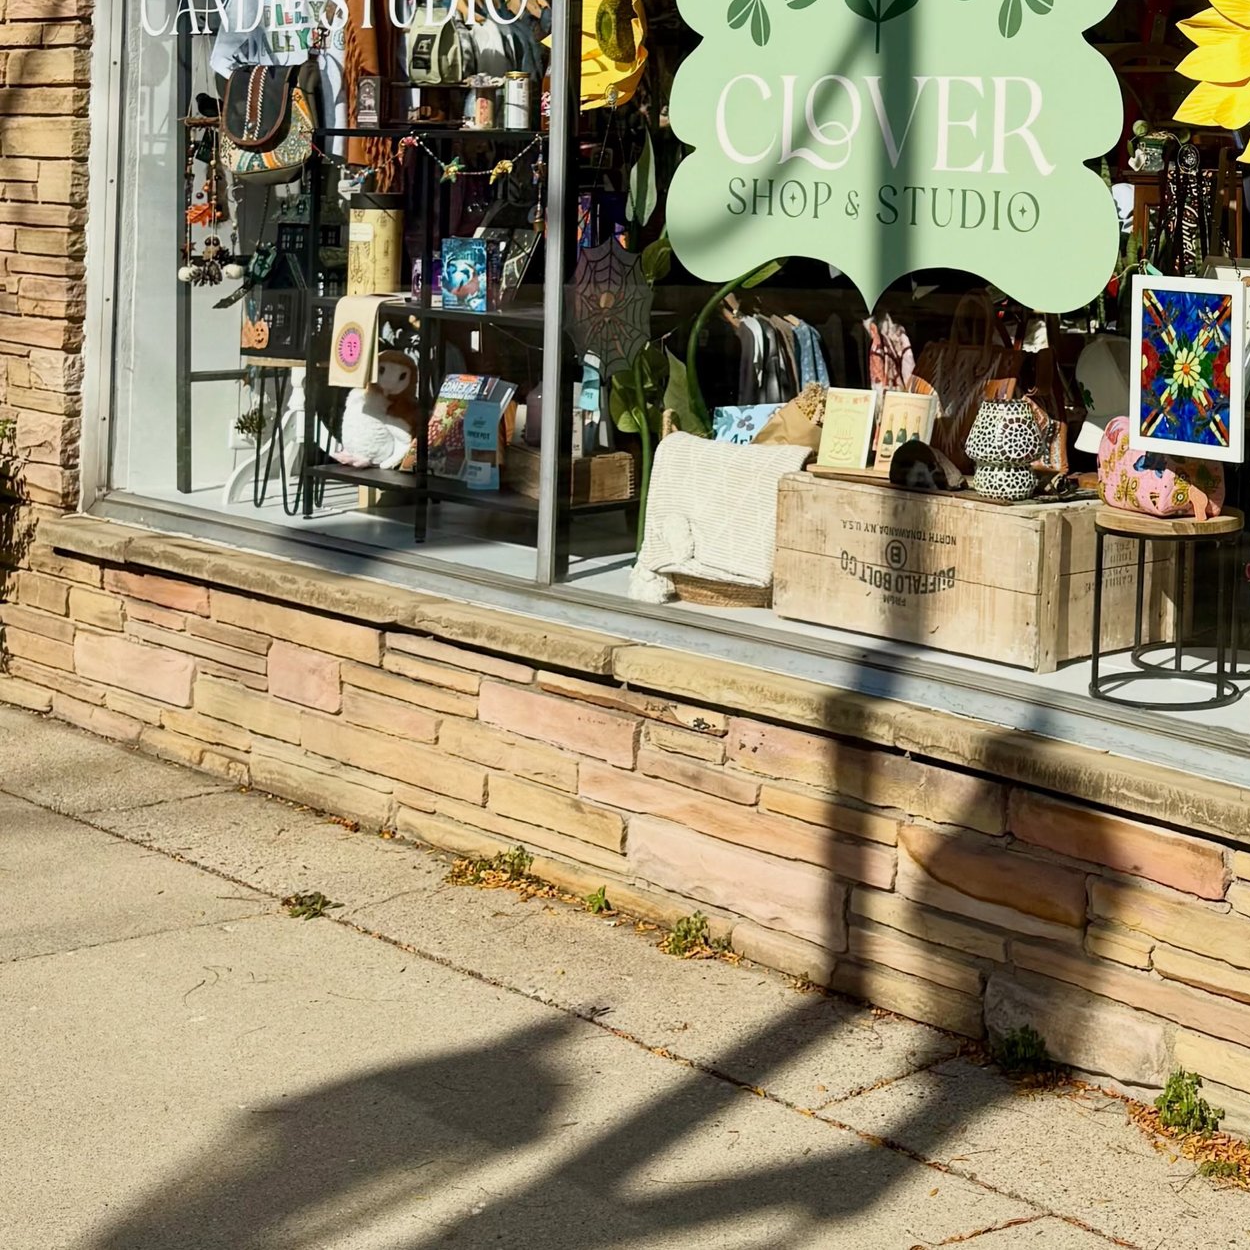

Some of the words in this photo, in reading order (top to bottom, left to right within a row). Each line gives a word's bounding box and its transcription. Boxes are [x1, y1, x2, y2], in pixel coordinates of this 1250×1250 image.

[715, 73, 1057, 177] CLOVER
[726, 176, 832, 220] SHOP
[844, 189, 861, 221] &
[875, 183, 1041, 233] STUDIO
[928, 532, 957, 546] NORTH
[858, 564, 892, 591] BOLT
[896, 566, 956, 595] BUFFALO
[883, 594, 907, 607] FROM
